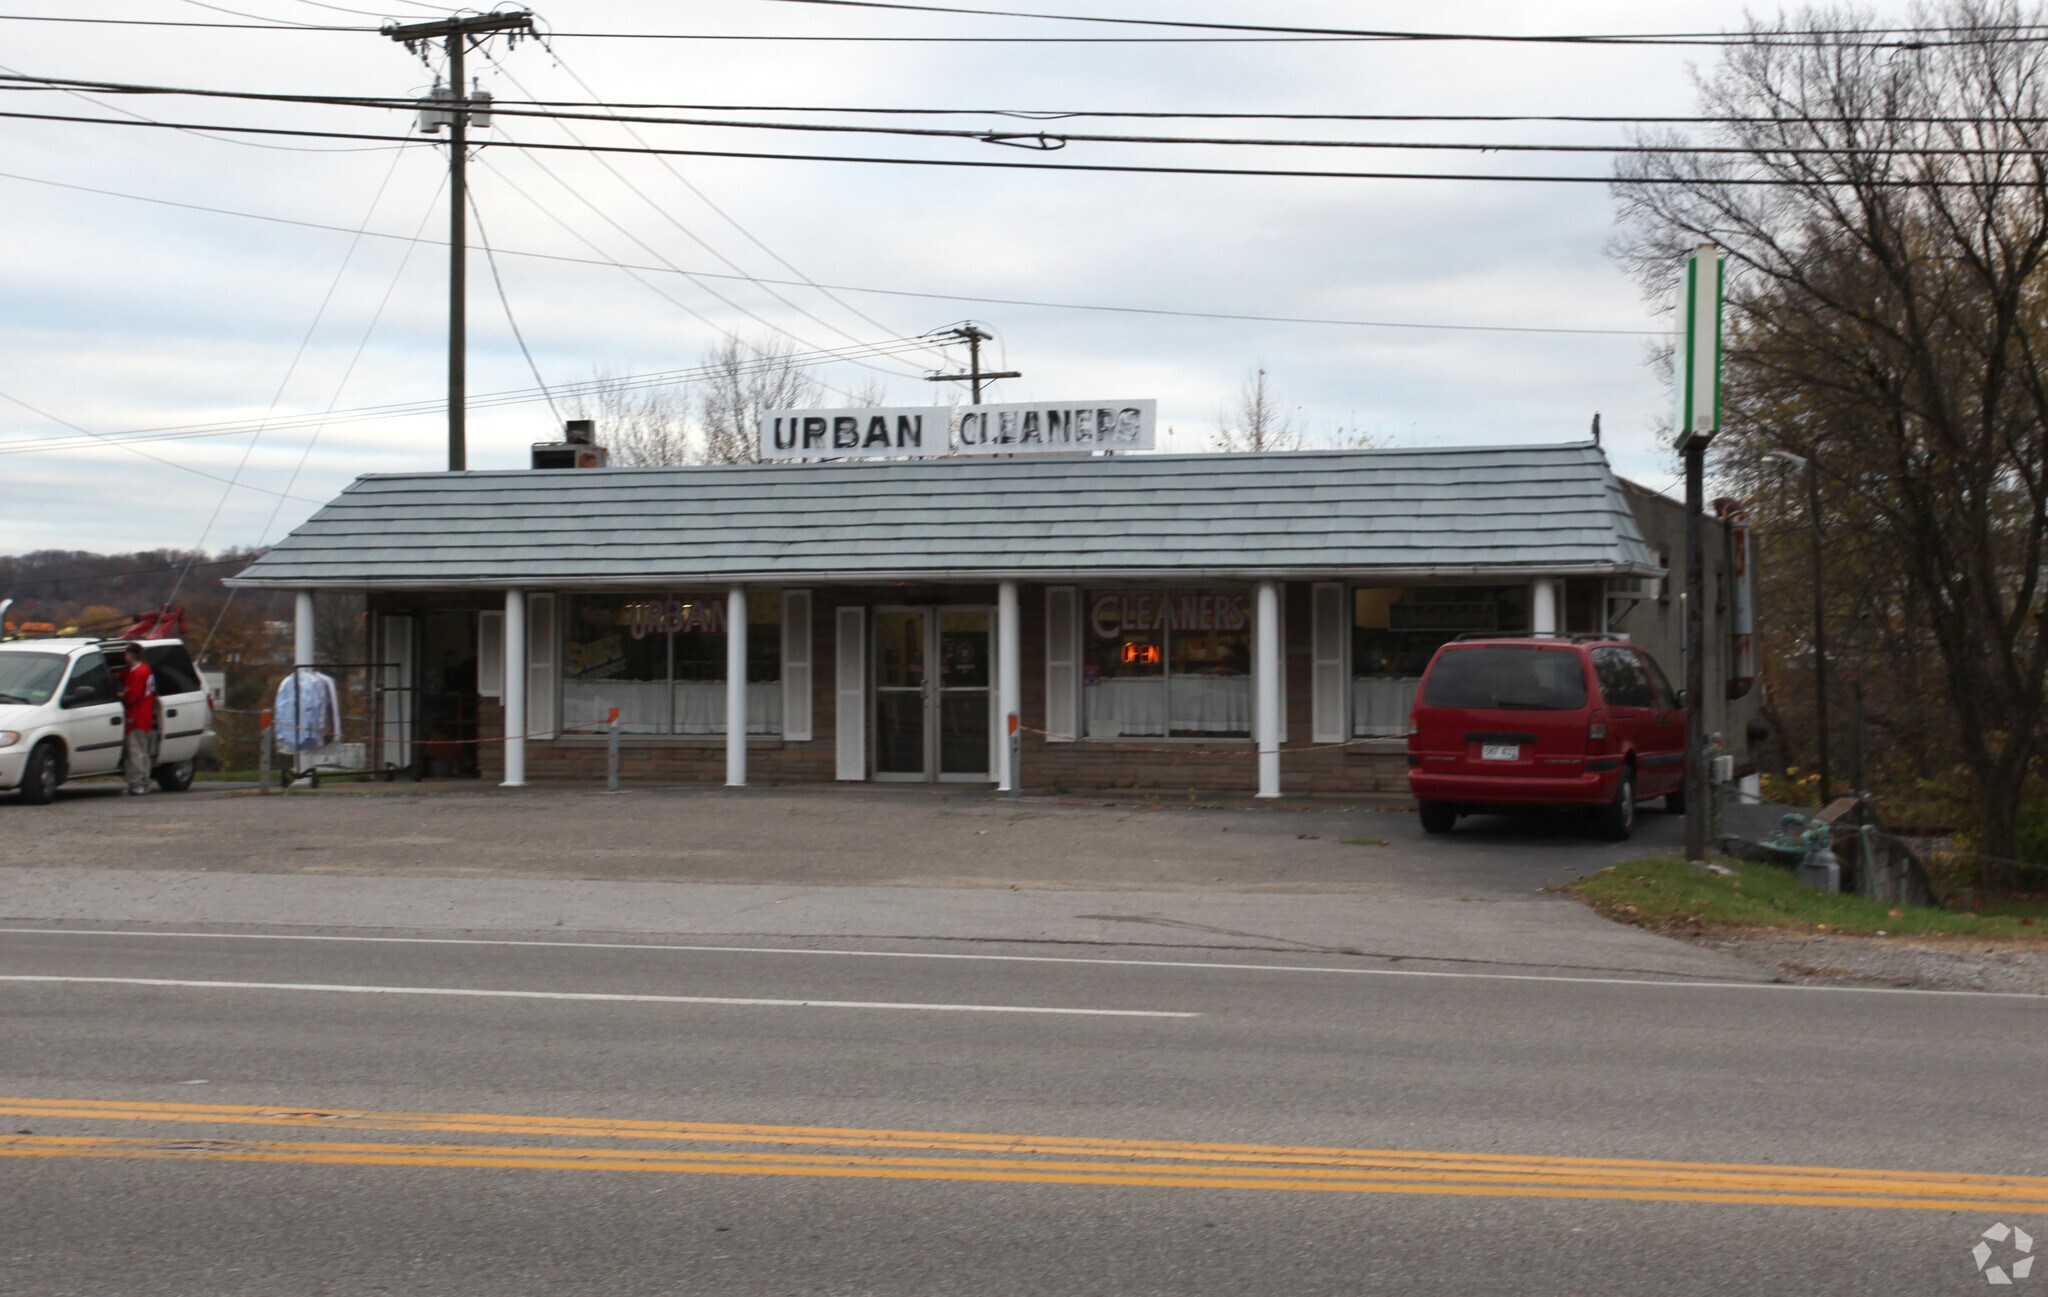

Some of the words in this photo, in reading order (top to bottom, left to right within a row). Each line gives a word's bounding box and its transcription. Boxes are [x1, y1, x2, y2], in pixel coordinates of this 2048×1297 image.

[774, 414, 922, 450] URBAN
[959, 407, 1142, 446] CLEANERS
[630, 599, 728, 640] URBAN
[1091, 594, 1247, 639] CLEANERS
[1121, 642, 1160, 663] OPEN
